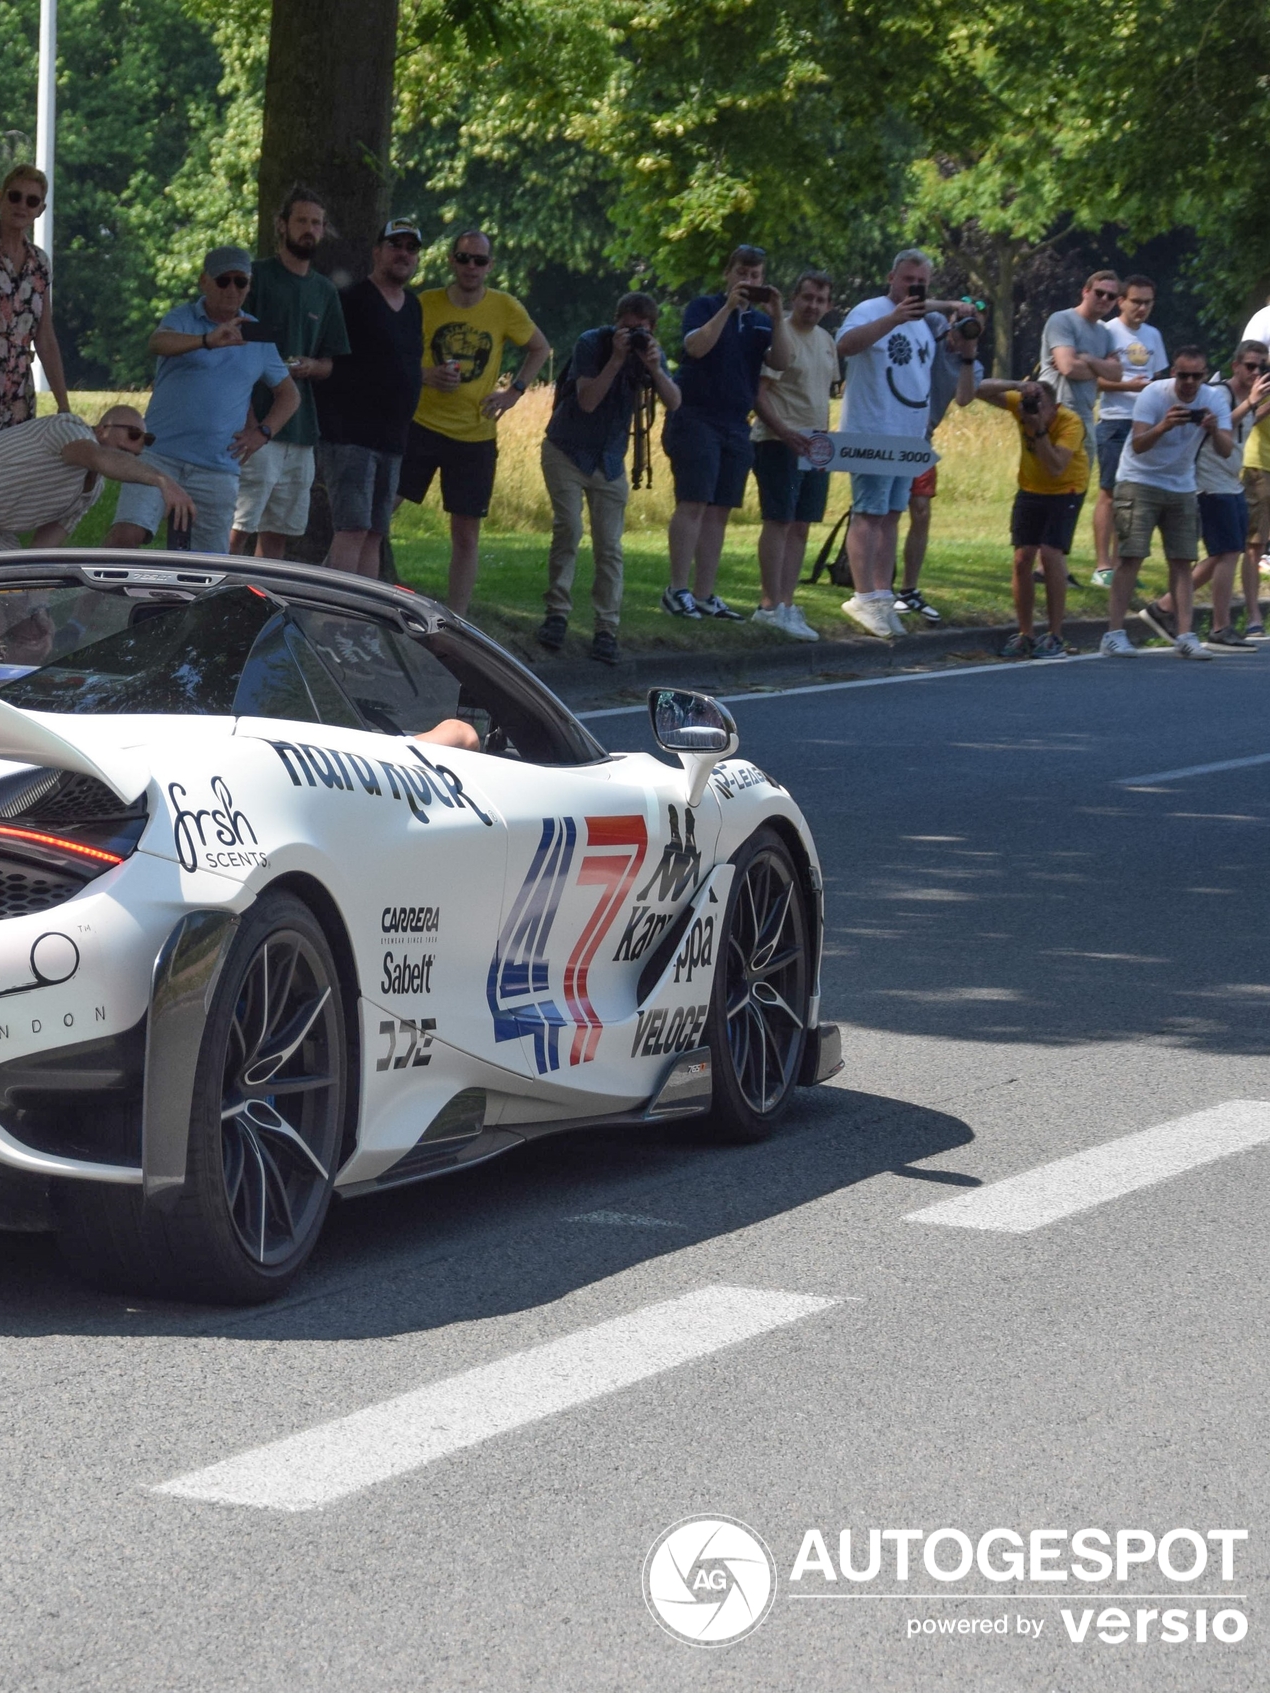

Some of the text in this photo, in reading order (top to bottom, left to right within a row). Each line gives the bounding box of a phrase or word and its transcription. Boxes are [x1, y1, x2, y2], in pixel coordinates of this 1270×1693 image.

[840, 447, 895, 461] GUMBALL
[898, 450, 930, 463] 3000
[168, 775, 259, 874] frsh
[205, 851, 268, 869] SCENTS
[381, 906, 440, 934] CARRERA
[407, 936, 423, 944] SINCE
[380, 950, 433, 995] Sabelt
[630, 1004, 709, 1059] VELOCE
